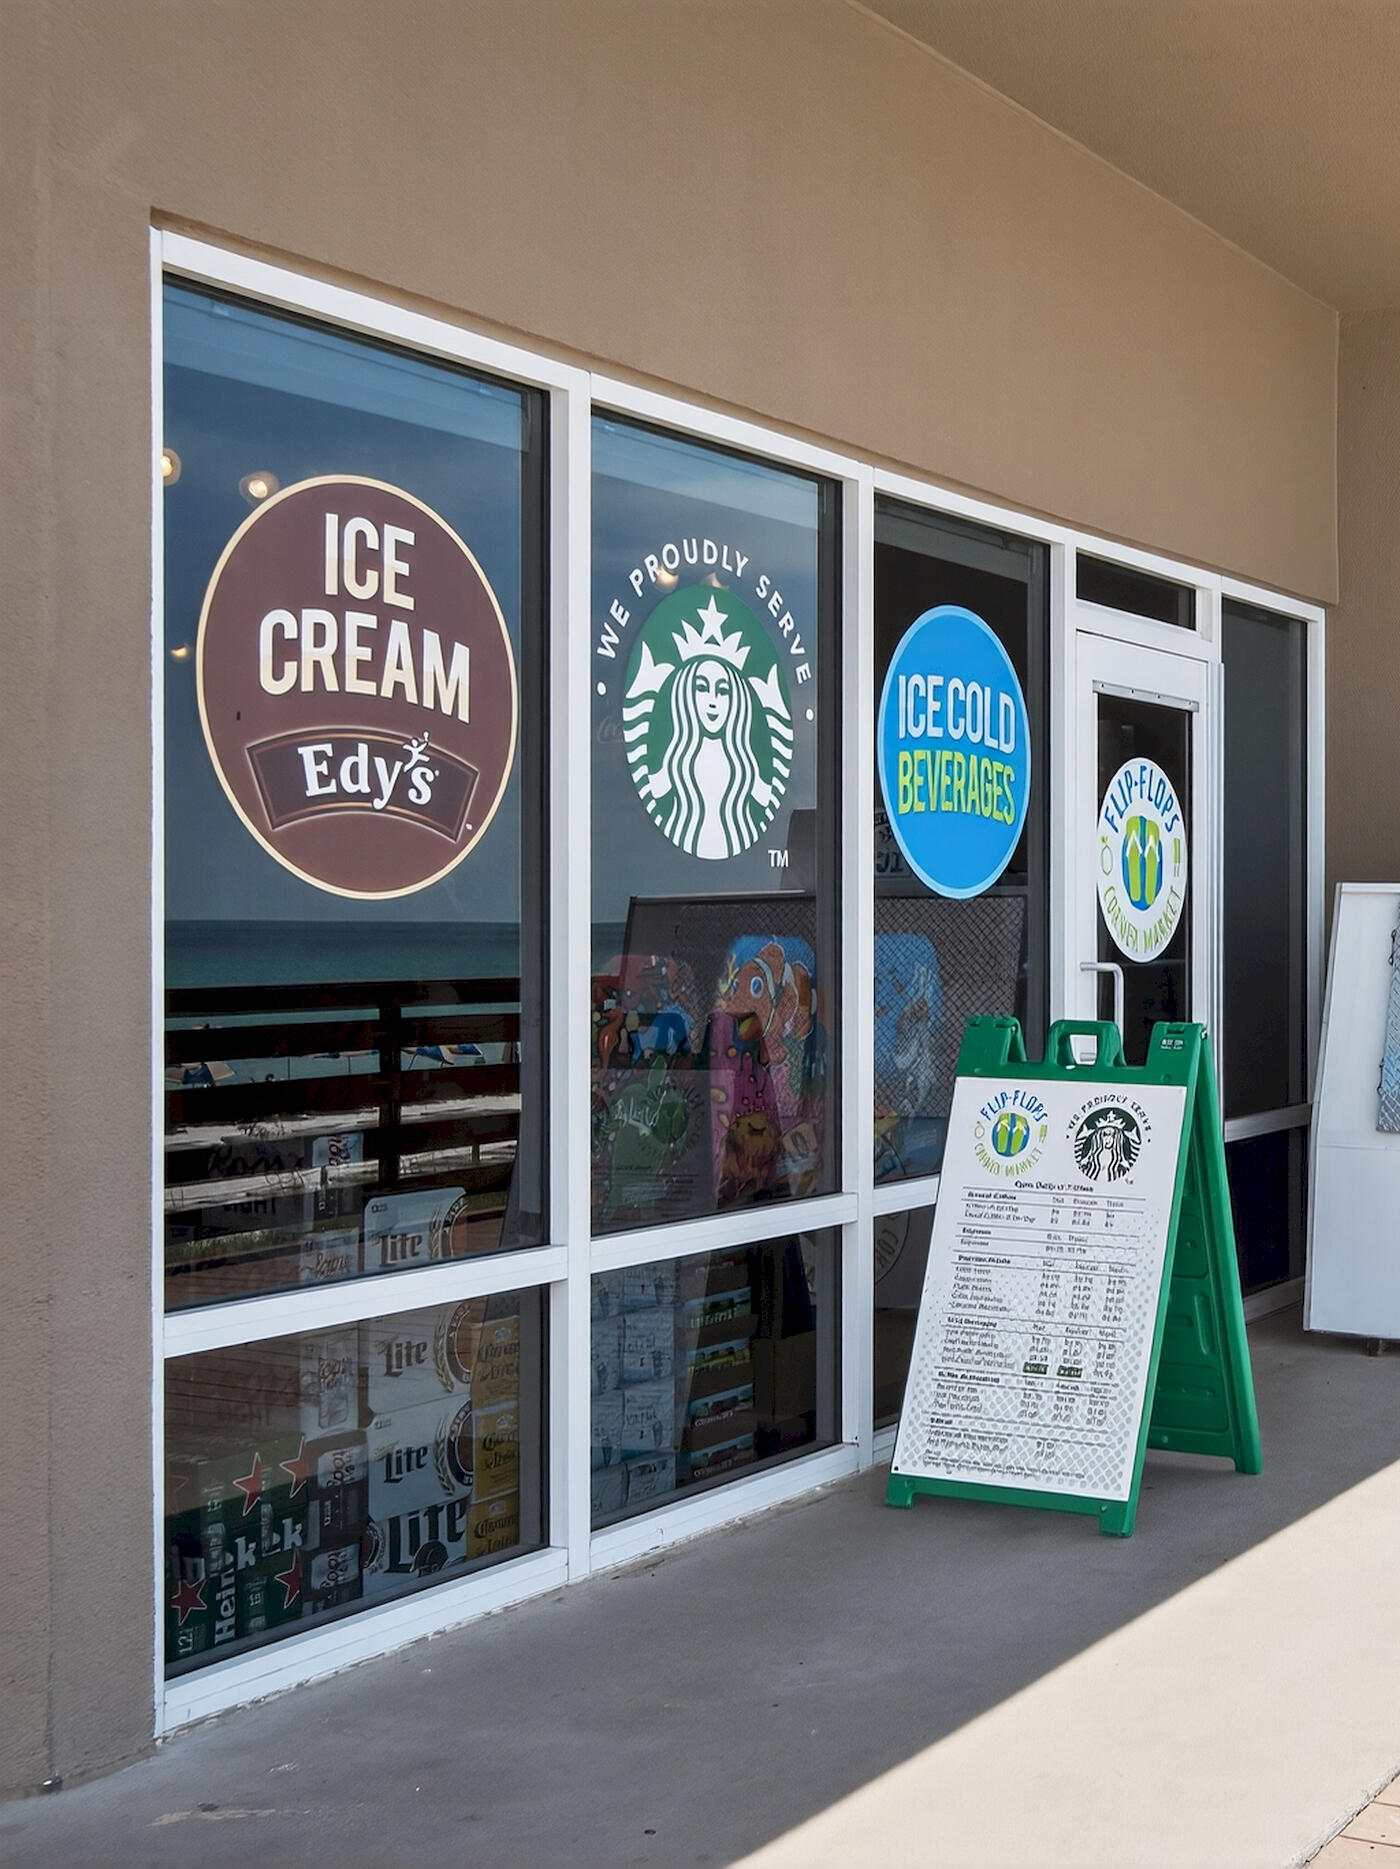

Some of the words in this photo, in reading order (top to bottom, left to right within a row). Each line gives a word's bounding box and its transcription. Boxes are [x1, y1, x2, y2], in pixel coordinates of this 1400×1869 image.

[325, 512, 416, 611] ICE
[598, 598, 631, 661] WE
[630, 537, 751, 599] PROUDLY
[756, 574, 814, 686] SERVE
[258, 608, 471, 724] CREAM
[898, 674, 945, 739] ICE
[947, 677, 1017, 755] COLD
[297, 736, 438, 810] Edy's
[898, 749, 1017, 826] BEVERAGES
[1103, 763, 1181, 835] FLIP-FLOPS
[768, 849, 790, 869] TM
[379, 1232, 423, 1267] Lite
[383, 1339, 428, 1378] Lite
[383, 1443, 429, 1484] Lite
[384, 1499, 467, 1574] Lite
